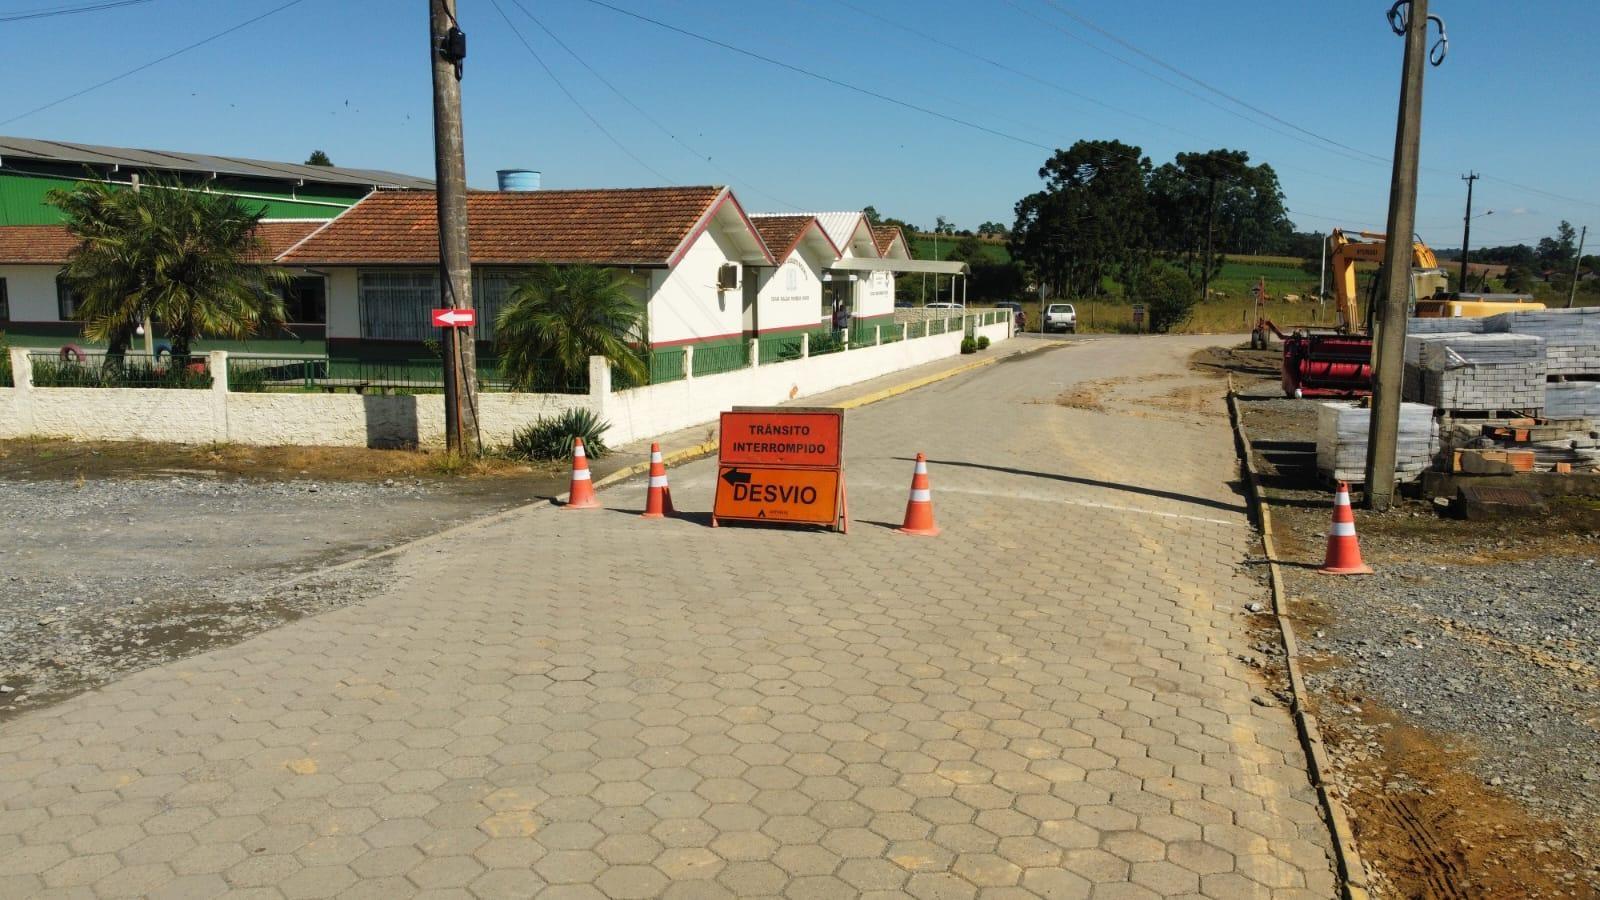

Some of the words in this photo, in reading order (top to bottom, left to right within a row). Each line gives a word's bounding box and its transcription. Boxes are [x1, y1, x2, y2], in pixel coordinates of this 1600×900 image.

[749, 424, 810, 436] TRÂNSITO
[733, 442, 826, 454] INTERROMPIDO
[733, 483, 817, 505] DESVIO
